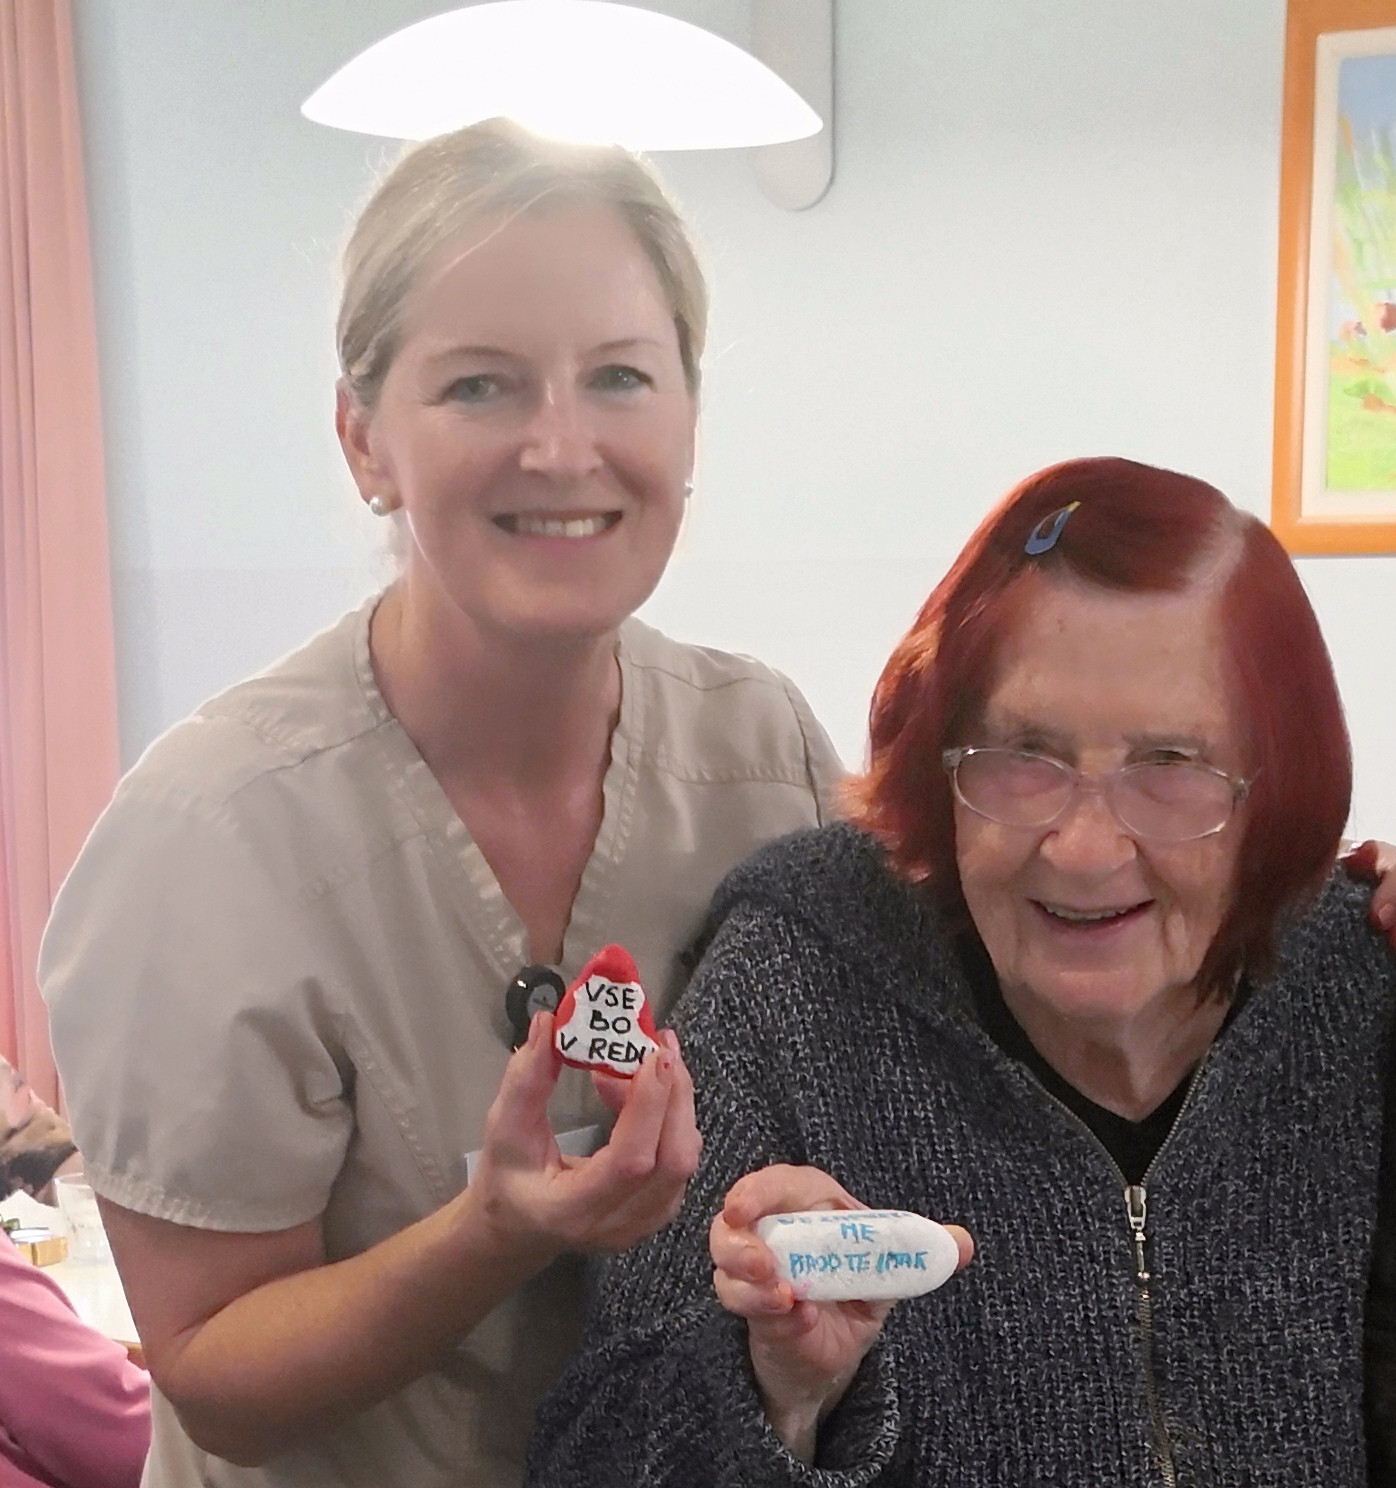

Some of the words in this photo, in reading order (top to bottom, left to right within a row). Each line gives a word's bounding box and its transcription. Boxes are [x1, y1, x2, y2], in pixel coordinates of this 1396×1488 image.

[585, 981, 638, 1010] VSE
[590, 1009, 632, 1034] BO
[559, 1032, 578, 1051] V
